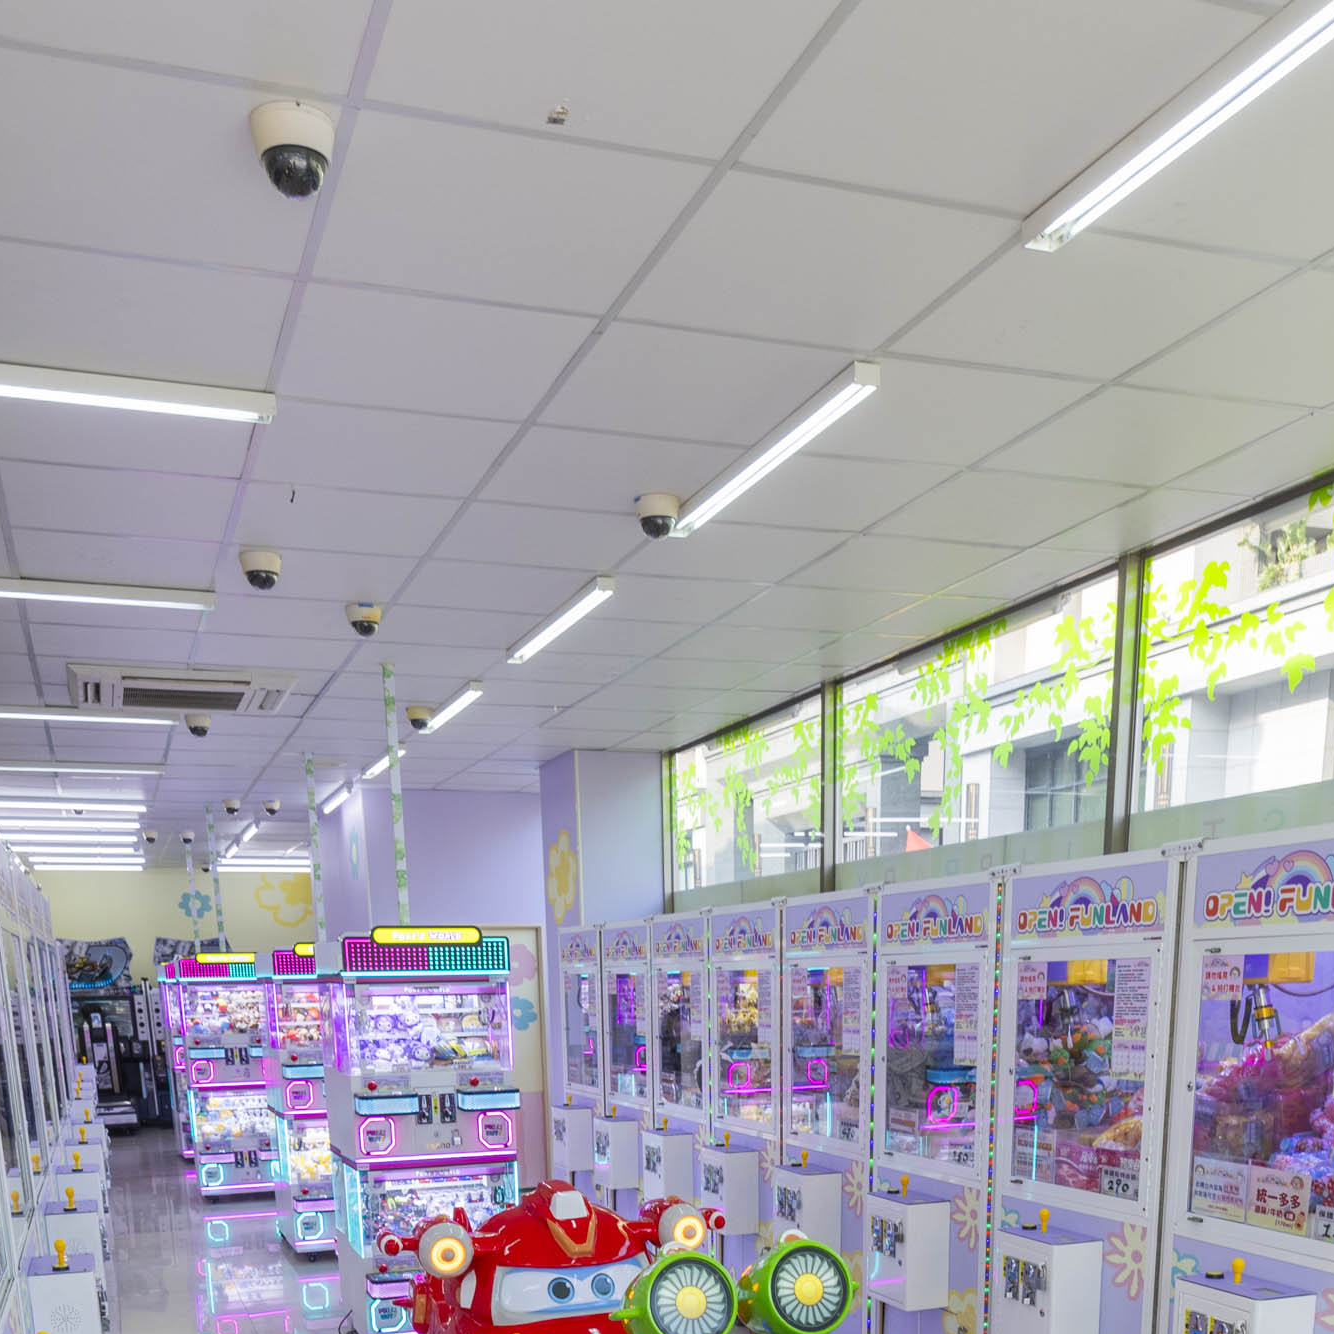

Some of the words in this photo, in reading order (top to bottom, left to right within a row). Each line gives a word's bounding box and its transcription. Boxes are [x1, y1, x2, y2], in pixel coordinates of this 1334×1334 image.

[1018, 908, 1064, 932] OPEN!
[1068, 899, 1157, 928] FUNLAND
[1204, 887, 1273, 922] OPEN!
[886, 921, 920, 941] OPEN!
[922, 913, 984, 938] FUNLAND
